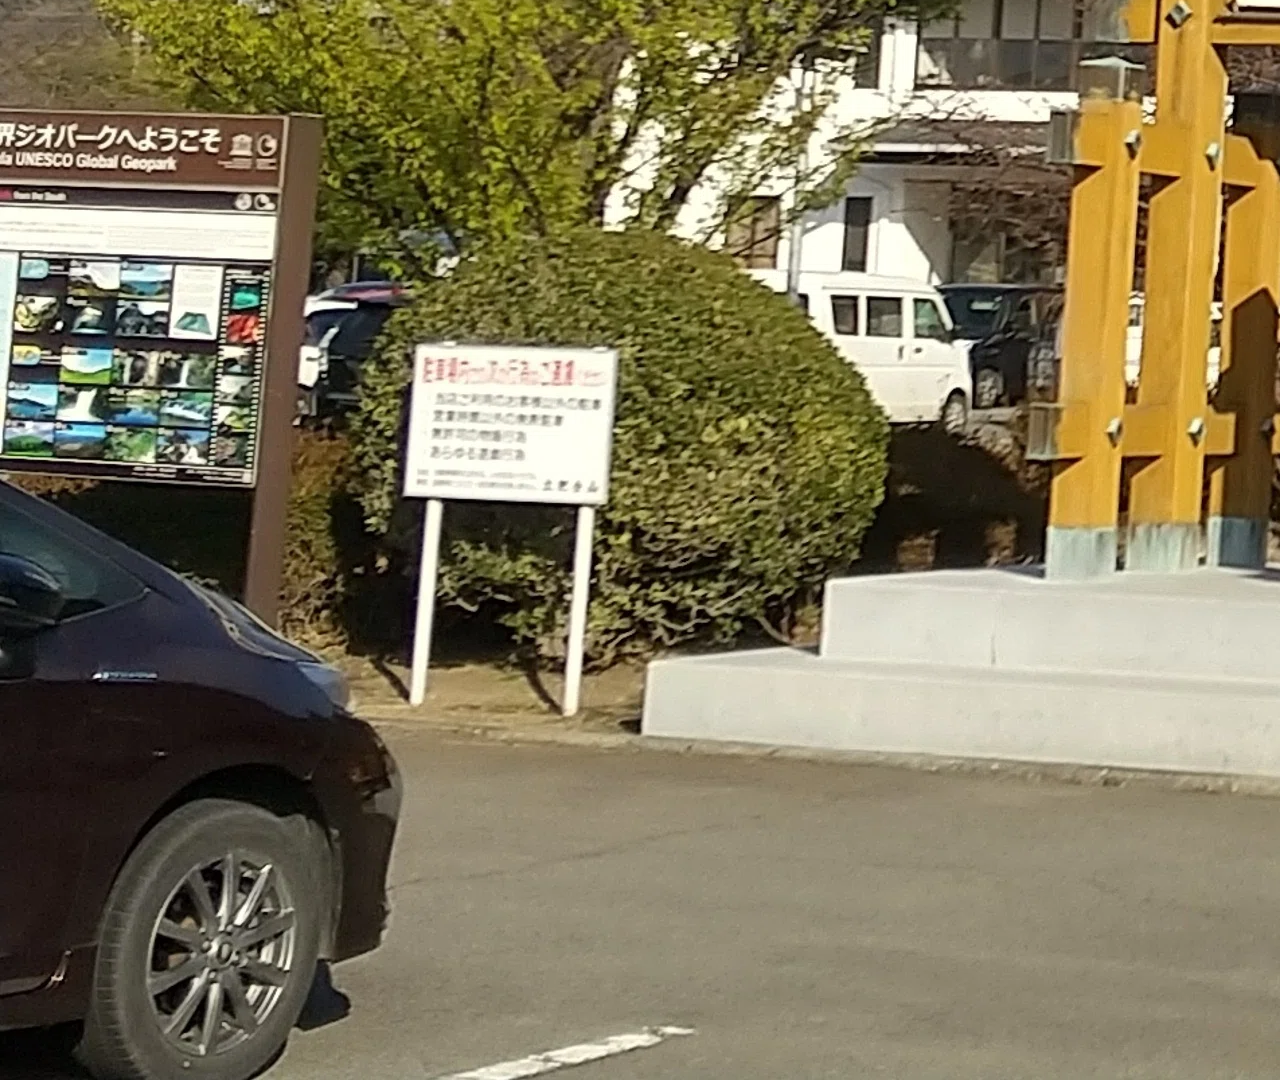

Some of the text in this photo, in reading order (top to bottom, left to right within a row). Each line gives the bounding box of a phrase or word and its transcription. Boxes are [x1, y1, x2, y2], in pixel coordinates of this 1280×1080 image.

[0, 122, 222, 154] 界ジオパークへようこそ
[15, 151, 73, 168] UNESCO
[76, 153, 119, 170] Global
[120, 155, 177, 173] Geopark
